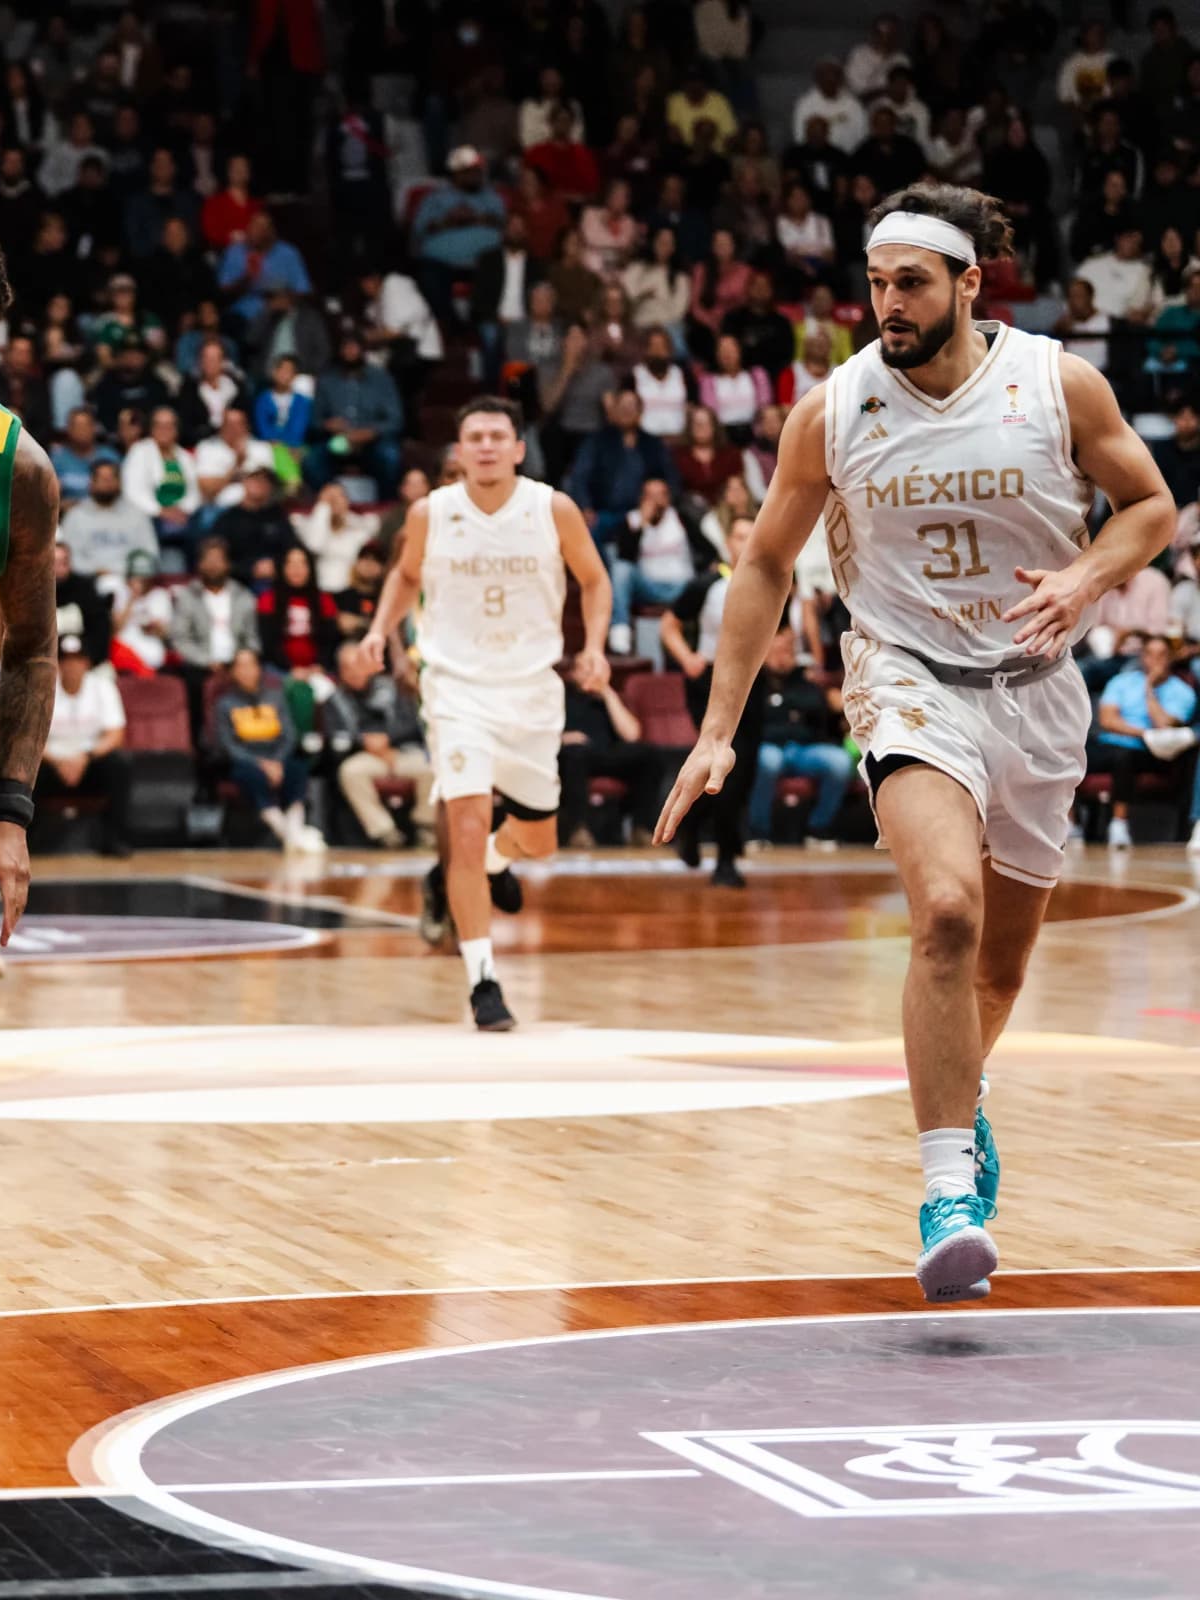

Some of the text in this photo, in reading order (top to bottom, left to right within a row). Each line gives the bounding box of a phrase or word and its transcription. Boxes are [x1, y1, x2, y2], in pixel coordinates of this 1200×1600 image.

[866, 465, 1024, 508] MÉXICO
[917, 520, 990, 580] 31
[484, 585, 505, 617] 9
